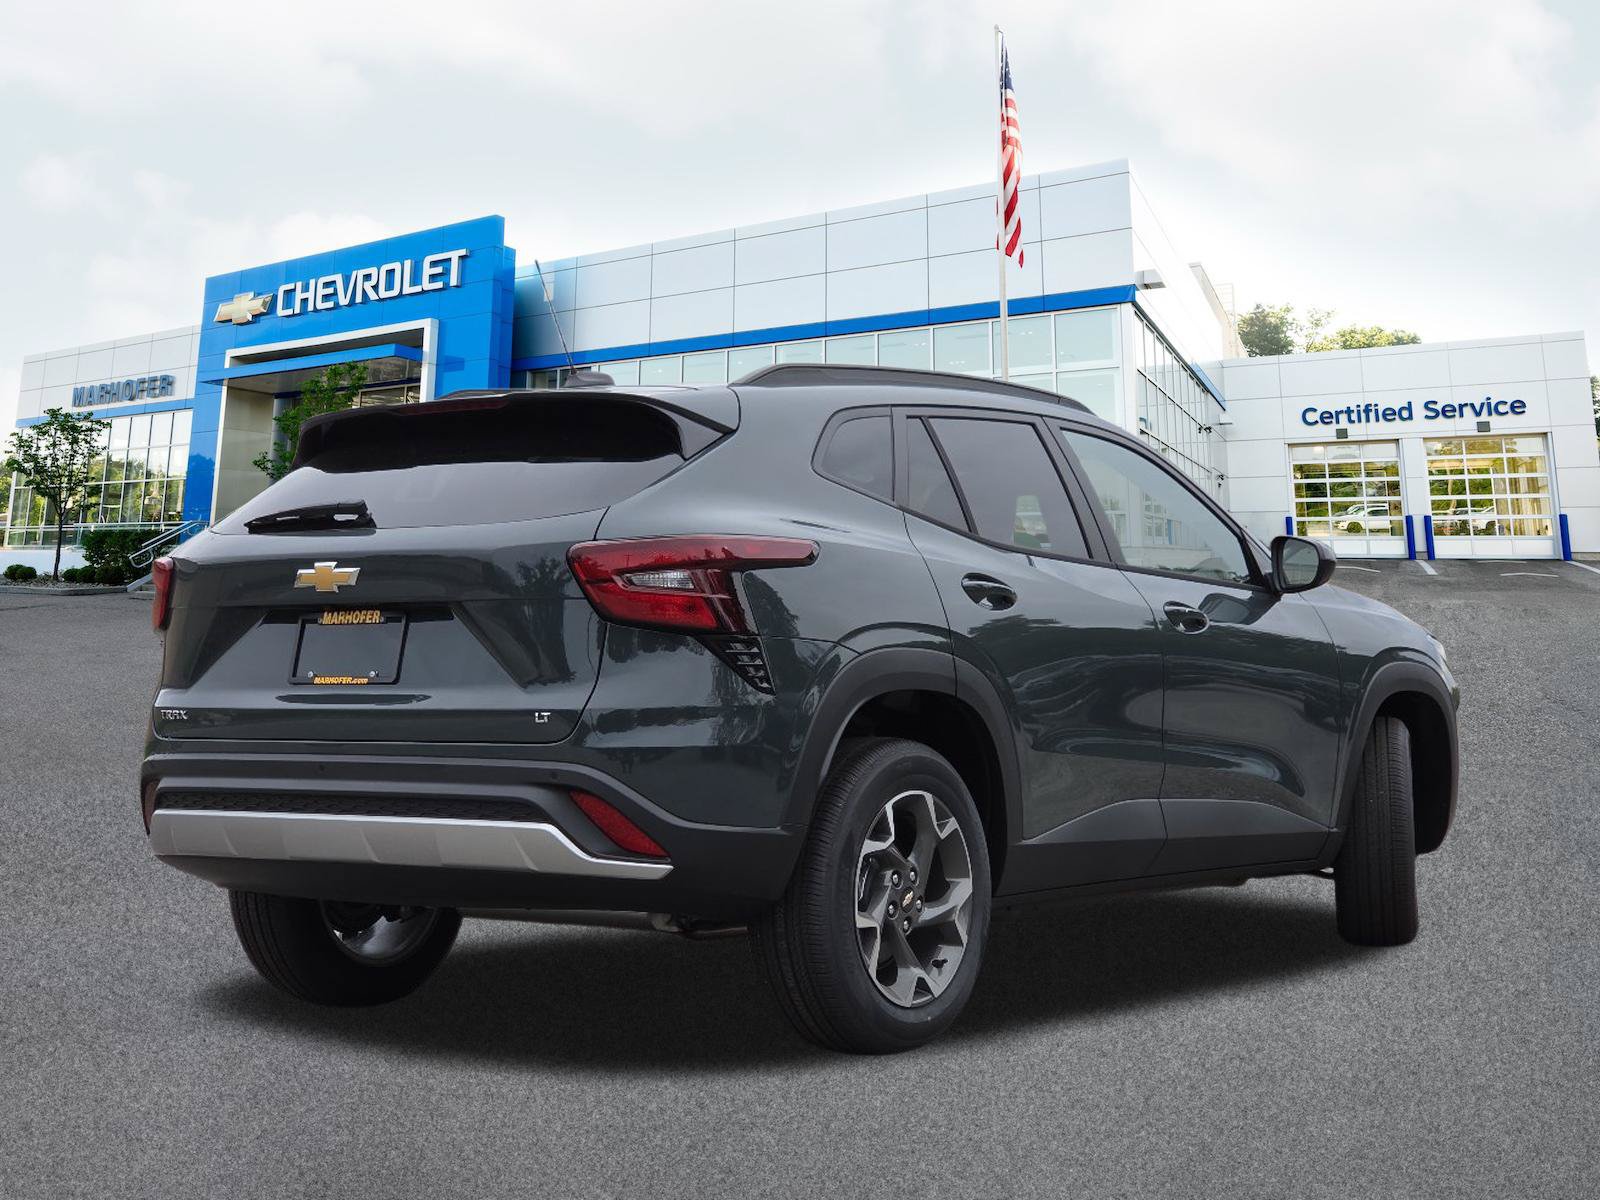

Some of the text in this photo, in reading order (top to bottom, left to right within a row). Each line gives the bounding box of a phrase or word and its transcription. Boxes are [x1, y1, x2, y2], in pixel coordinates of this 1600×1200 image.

[276, 248, 469, 317] CHEVROLET
[72, 374, 175, 408] MARHOFER
[1301, 396, 1527, 426] Certified Service
[322, 609, 381, 625] MARHOFER
[313, 676, 369, 685] MARHOFER.com
[160, 709, 188, 720] TRAX
[534, 711, 552, 723] LT
